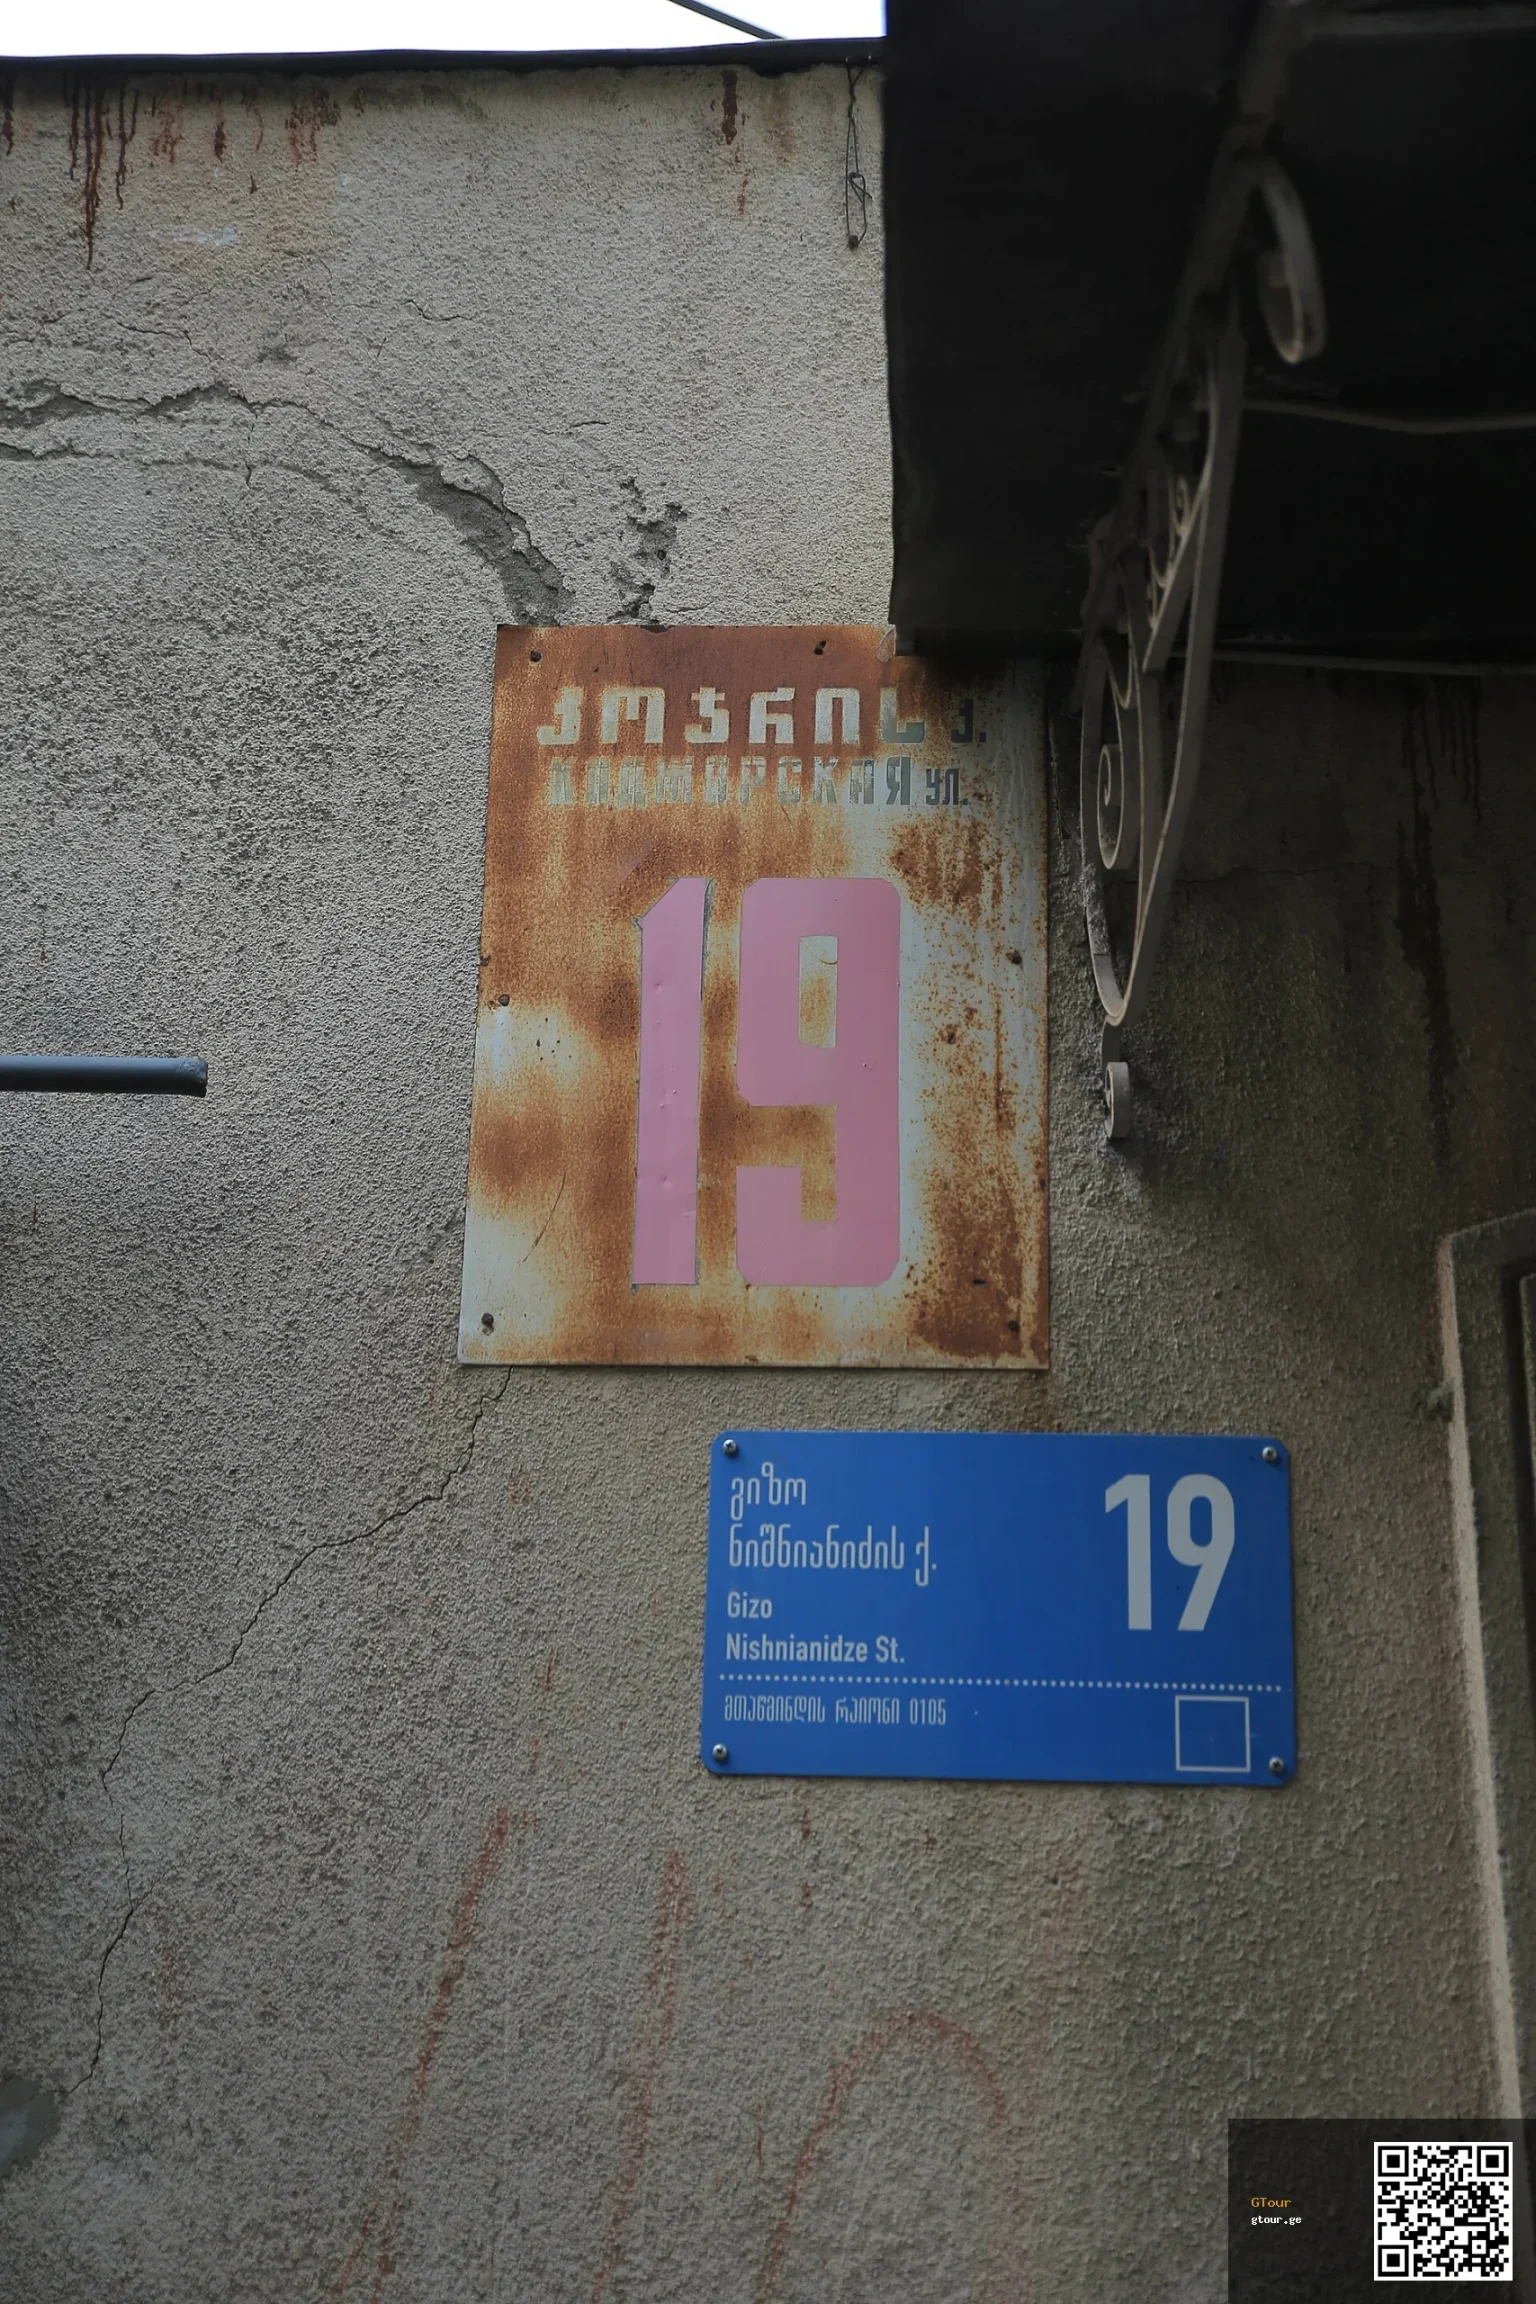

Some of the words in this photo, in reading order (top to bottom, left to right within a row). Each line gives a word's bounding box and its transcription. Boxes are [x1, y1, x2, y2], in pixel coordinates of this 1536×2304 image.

[535, 686, 926, 745] კოჯრის
[925, 767, 969, 805] ул.
[632, 876, 900, 1287] 19
[730, 1461, 807, 1521] გიზო
[728, 1523, 905, 1570] ნიშნიანიძის
[914, 1525, 938, 1587] ქ.
[1105, 1472, 1236, 1632] 19
[727, 1591, 773, 1619] Gizo
[726, 1632, 868, 1662] Nishnianidze
[875, 1635, 906, 1664] St.
[724, 1694, 826, 1723] მთაწმინდის
[835, 1696, 900, 1725] რაიონი
[909, 1698, 947, 1726] 0105
